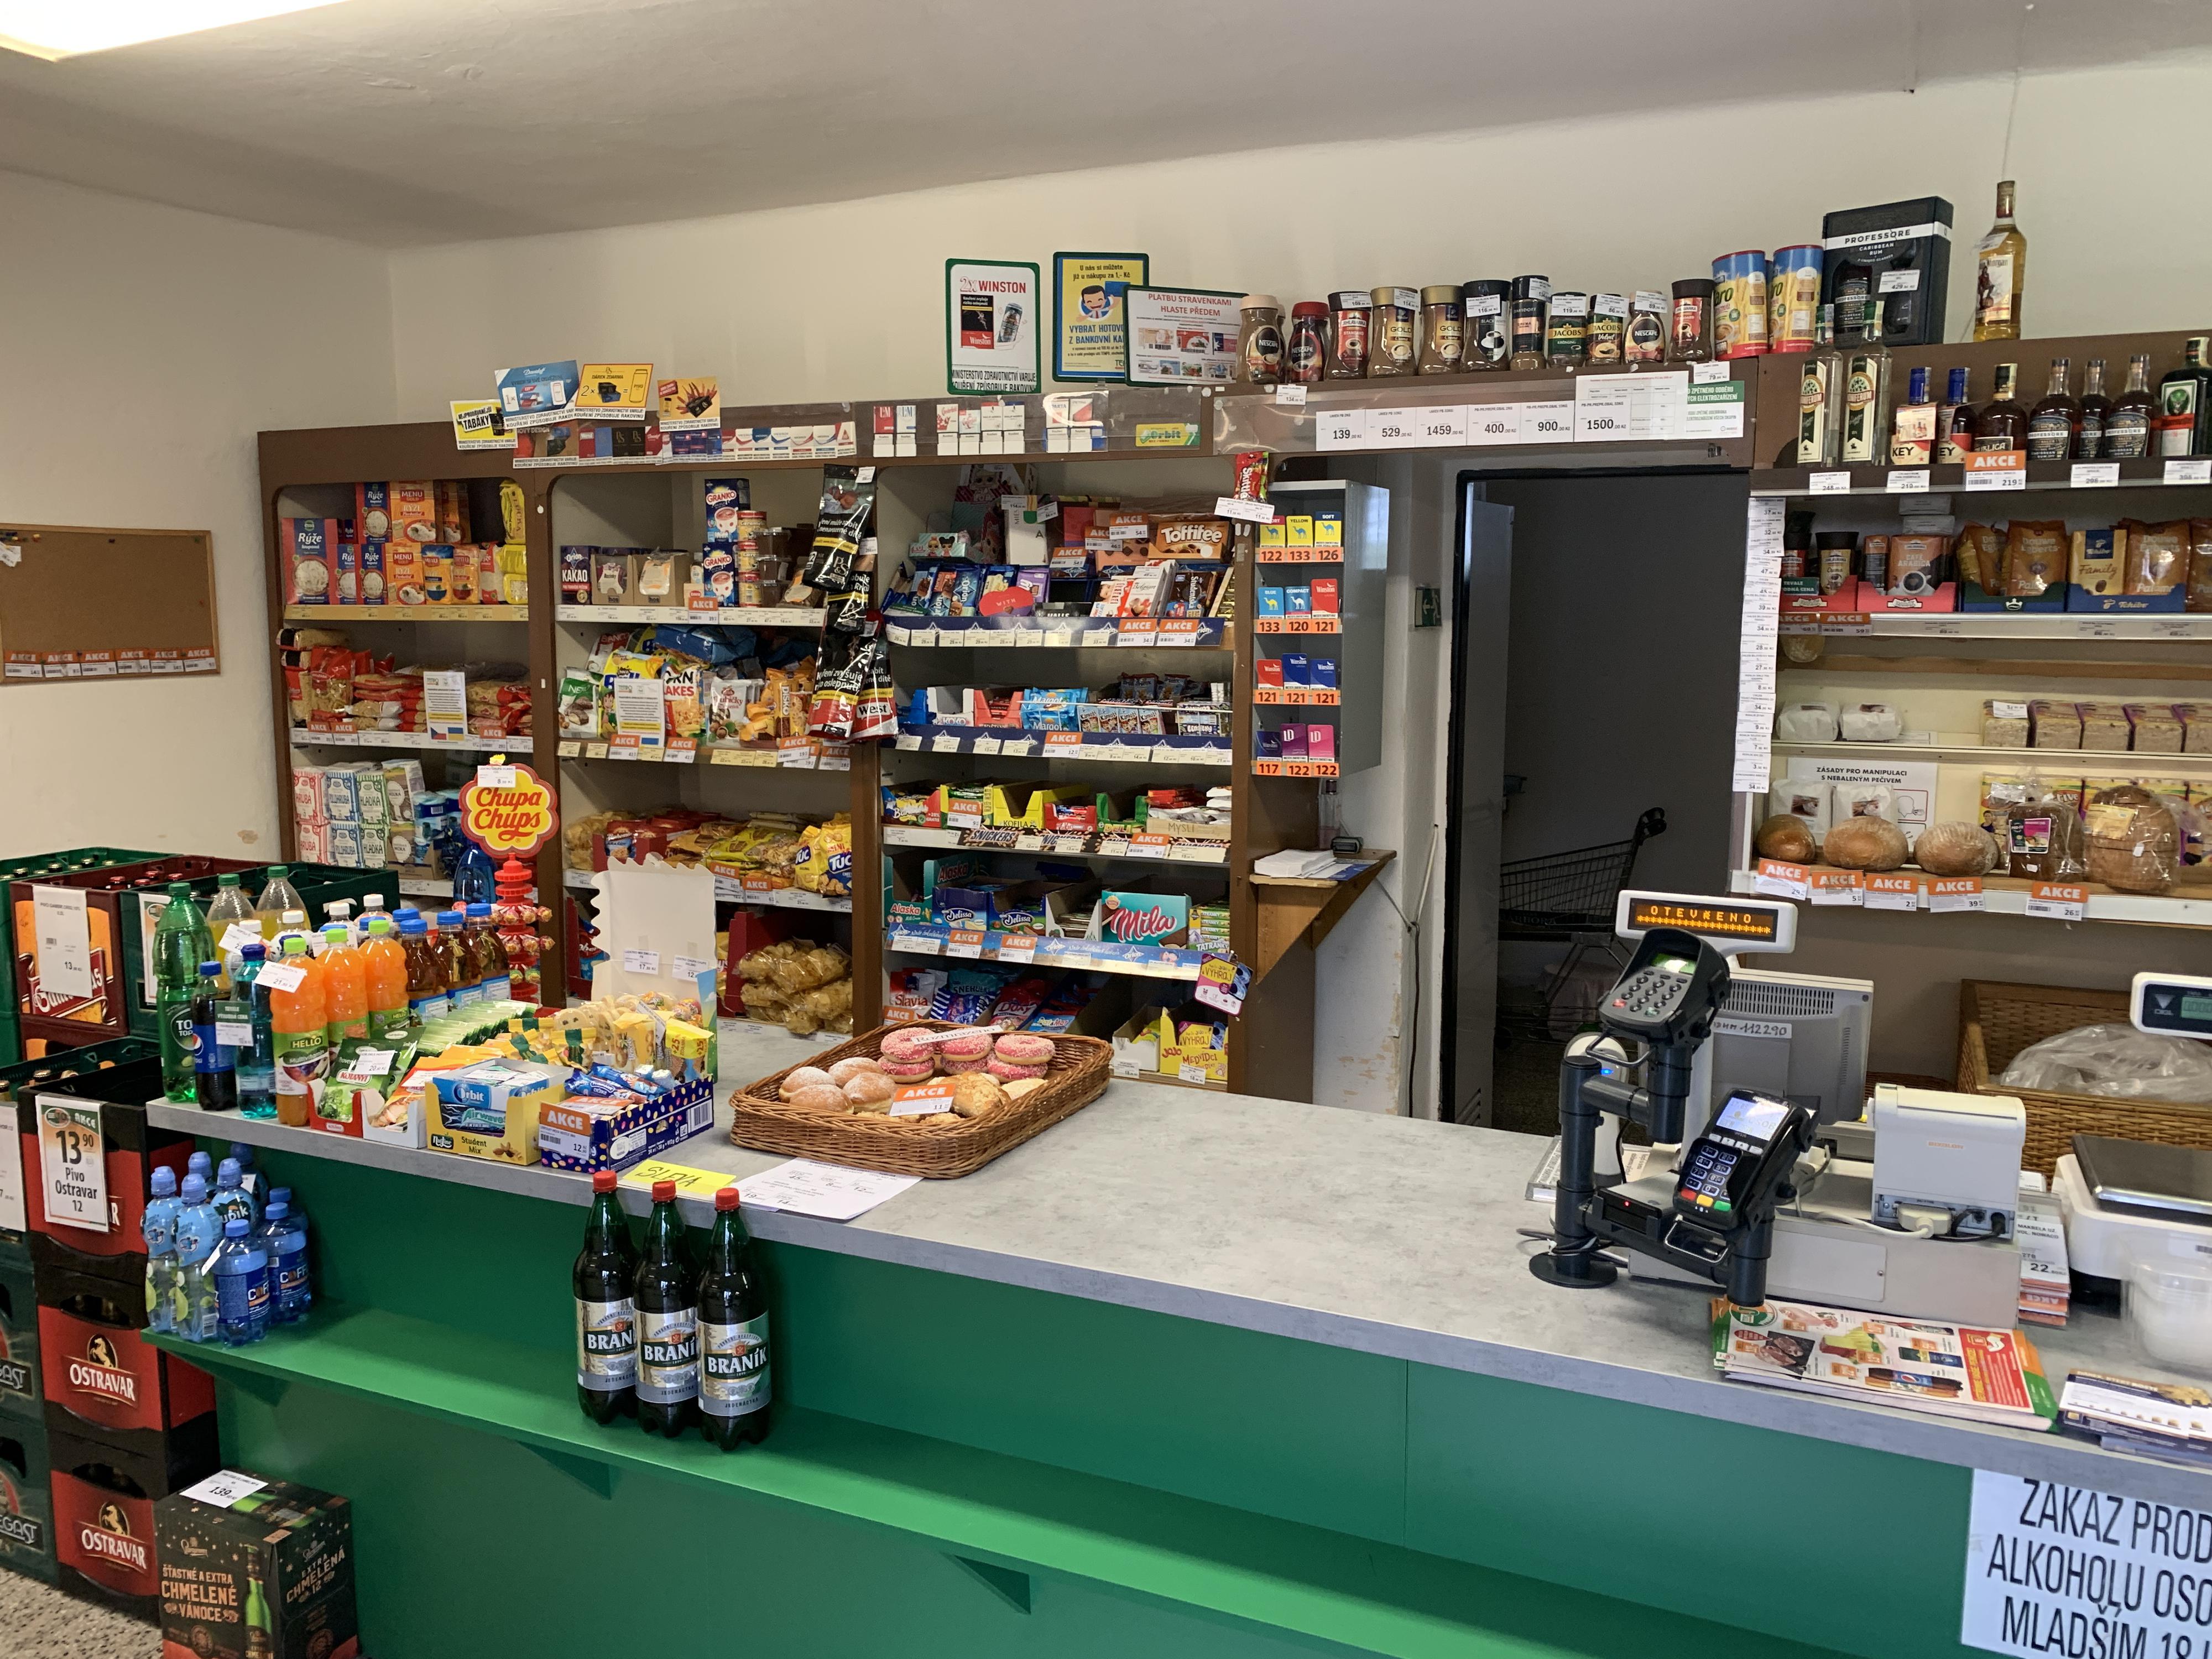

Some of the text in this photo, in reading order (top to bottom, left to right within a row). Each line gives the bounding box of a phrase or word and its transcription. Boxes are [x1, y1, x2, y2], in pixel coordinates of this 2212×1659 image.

[1844, 228, 1911, 246] PROFESSORE
[1859, 242, 1895, 252] CARIBBEAN
[978, 280, 1026, 294] WINSTON
[1149, 293, 1232, 306] PLATBU STRAVENKAMI
[1161, 305, 1220, 316] HLASTE PŘEDEM
[1439, 325, 1462, 333] GOLD
[1553, 328, 1582, 337] JACOBS
[1593, 324, 1621, 332] JACOBS
[969, 337, 991, 345] Winston
[1076, 335, 1111, 344] BANKOVNÍ
[1697, 392, 1739, 401] ELEKTROZAŘÍZENÍ
[463, 415, 489, 430] TABÁKY
[1892, 446, 1914, 458] KEY
[1974, 455, 2016, 467] AKCE
[367, 490, 384, 500] Rýže
[400, 489, 423, 498] MENU
[706, 491, 737, 502] GRANKO
[1115, 515, 1143, 524] AKCE
[298, 532, 323, 544] Rýže
[1162, 523, 1223, 544] Toffifee
[364, 552, 380, 562] Rýže
[393, 552, 413, 561] MENU
[1058, 547, 1083, 557] AKCE
[1261, 550, 1338, 561] 122 133 126
[704, 555, 732, 567] GRANKO
[1898, 559, 1931, 567] ARABICA
[562, 569, 588, 582] KAKAO
[2078, 563, 2117, 578] Family
[692, 600, 714, 609] AKCE
[1827, 614, 1863, 624] AKCE
[1124, 621, 1152, 631] AKCE
[1165, 621, 1193, 631] AKCE
[1259, 621, 1334, 632] 133 120 121
[1032, 696, 1063, 706] Margot
[1259, 692, 1334, 703] 121 121 121
[857, 704, 886, 716] West
[1033, 722, 1063, 731] Margot
[614, 737, 636, 746] AKCE
[671, 739, 694, 749] AKCE
[1050, 734, 1078, 743] AKCE
[1259, 764, 1337, 776] 117 122 122
[1816, 765, 1845, 775] ZÁSADY
[1864, 767, 1908, 776] MANIPULACI
[1828, 774, 1872, 783] NEBALENÝM
[1874, 775, 1902, 784] PEČIVEM
[476, 787, 542, 807] Chupa
[952, 802, 977, 813] AKCE
[474, 808, 541, 830] Chups
[1104, 823, 1131, 834] DELI
[969, 830, 1018, 843] SNICKERS
[1136, 835, 1165, 845] AKCE
[795, 848, 810, 864] TUC
[829, 853, 852, 870] TUC
[714, 865, 736, 877] AKCE
[938, 863, 968, 882] Alaska
[1765, 864, 1803, 879] AKCE
[746, 880, 768, 889] AKCE
[1819, 873, 1856, 886] AKCE
[1872, 878, 1911, 891] AKCE
[1934, 880, 1974, 894] AKCE
[2041, 886, 2081, 899] AKCE
[890, 903, 921, 916] Alaska
[947, 910, 974, 922] Delissa
[1003, 912, 1032, 927] Delissa
[1110, 907, 1176, 942] Mila
[953, 931, 979, 943] AKCE
[1004, 937, 1031, 948] AKCE
[1196, 941, 1230, 951] TATRANKY
[895, 994, 929, 1007] Slavia
[1740, 1020, 1787, 1037] 112290
[290, 1036, 322, 1048] HELLO
[453, 1083, 485, 1103] Orbit
[902, 1086, 945, 1102] AKCE
[546, 1110, 583, 1131] AKCE
[55, 1130, 93, 1165] 13 90
[461, 1136, 487, 1147] Student
[468, 1145, 482, 1154] Mix
[65, 1167, 85, 1182] Pivo
[55, 1180, 97, 1199] Ostravar
[72, 1199, 83, 1212] 12
[2017, 1223, 2047, 1233] MAKRELA
[2030, 1262, 2049, 1272] 22
[707, 1347, 768, 1374] BRANÍK
[69, 1363, 135, 1402] OSTRAVAR
[208, 1485, 232, 1497] 139
[81, 1528, 147, 1570] OSTRAVAR
[301, 1553, 328, 1576] EXTRA
[162, 1563, 233, 1585] ŠŤASTNÉ A EXTRA
[286, 1543, 346, 1604] CHMELENÁ
[1986, 1533, 2146, 1612] ALKOHOLU
[161, 1579, 238, 1607] CHMELENÉ
[178, 1601, 222, 1623] VÁNOCE
[2002, 1595, 2148, 1659] MLADŠÍM
